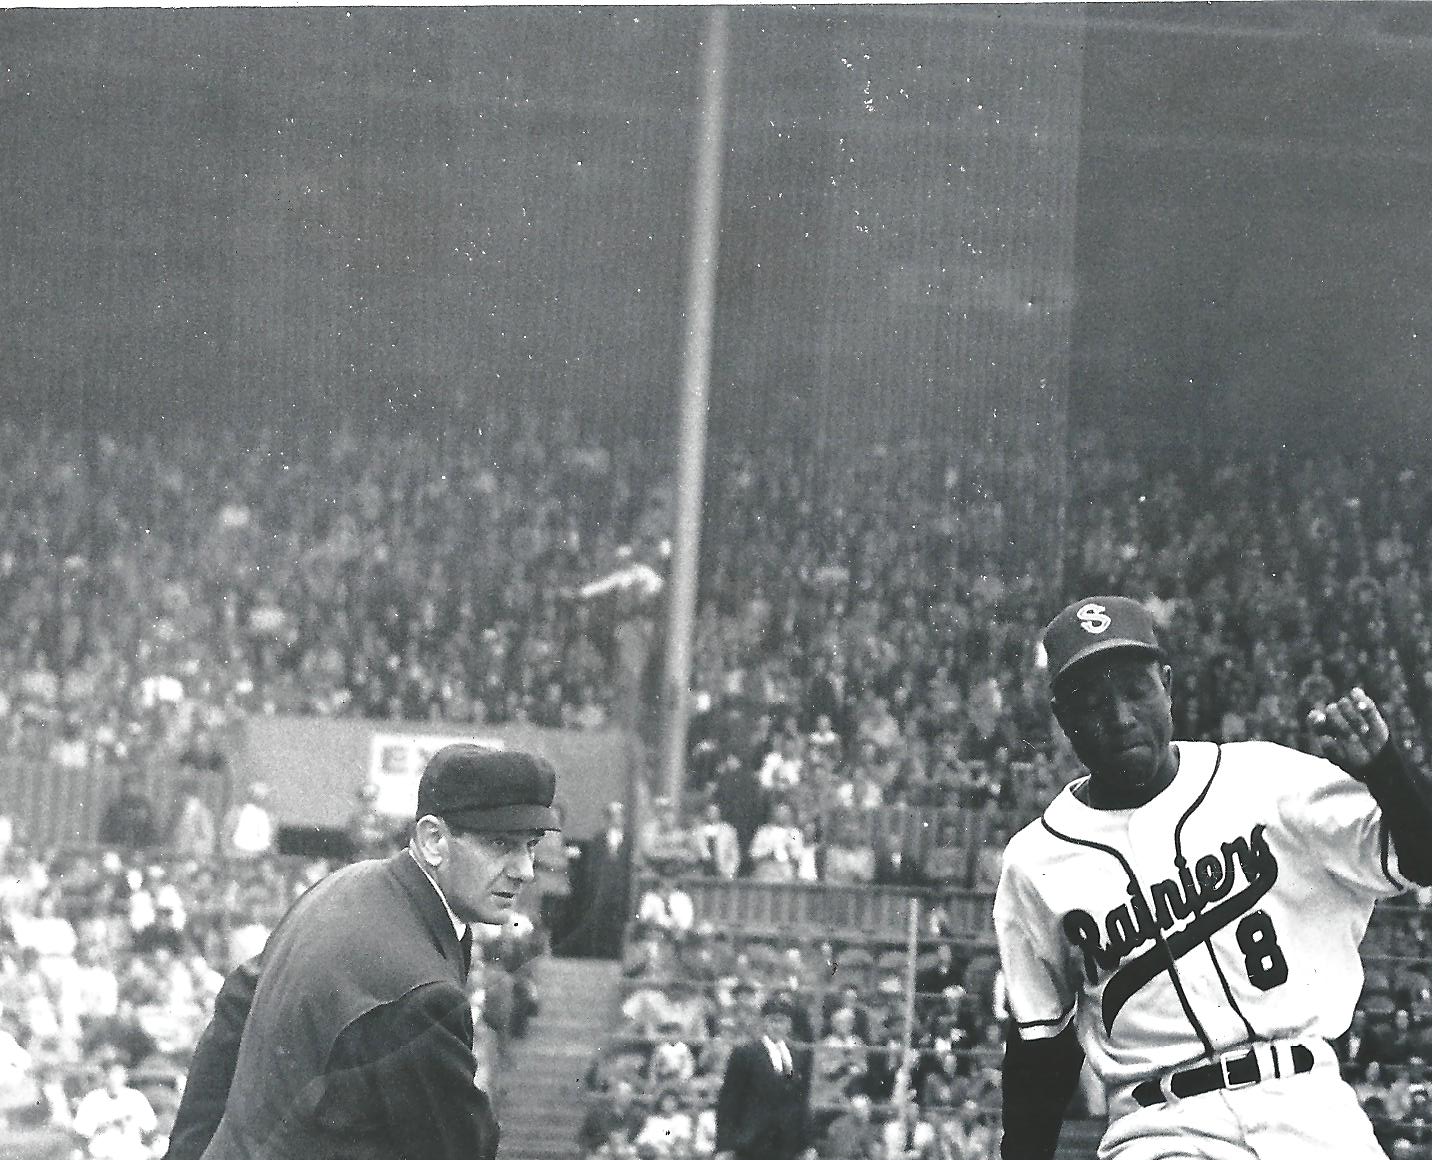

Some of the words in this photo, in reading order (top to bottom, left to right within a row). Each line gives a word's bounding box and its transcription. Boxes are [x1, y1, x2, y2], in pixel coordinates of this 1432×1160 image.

[1077, 603, 1111, 633] S
[1062, 825, 1278, 987] Rainiers
[1236, 911, 1289, 991] 8
